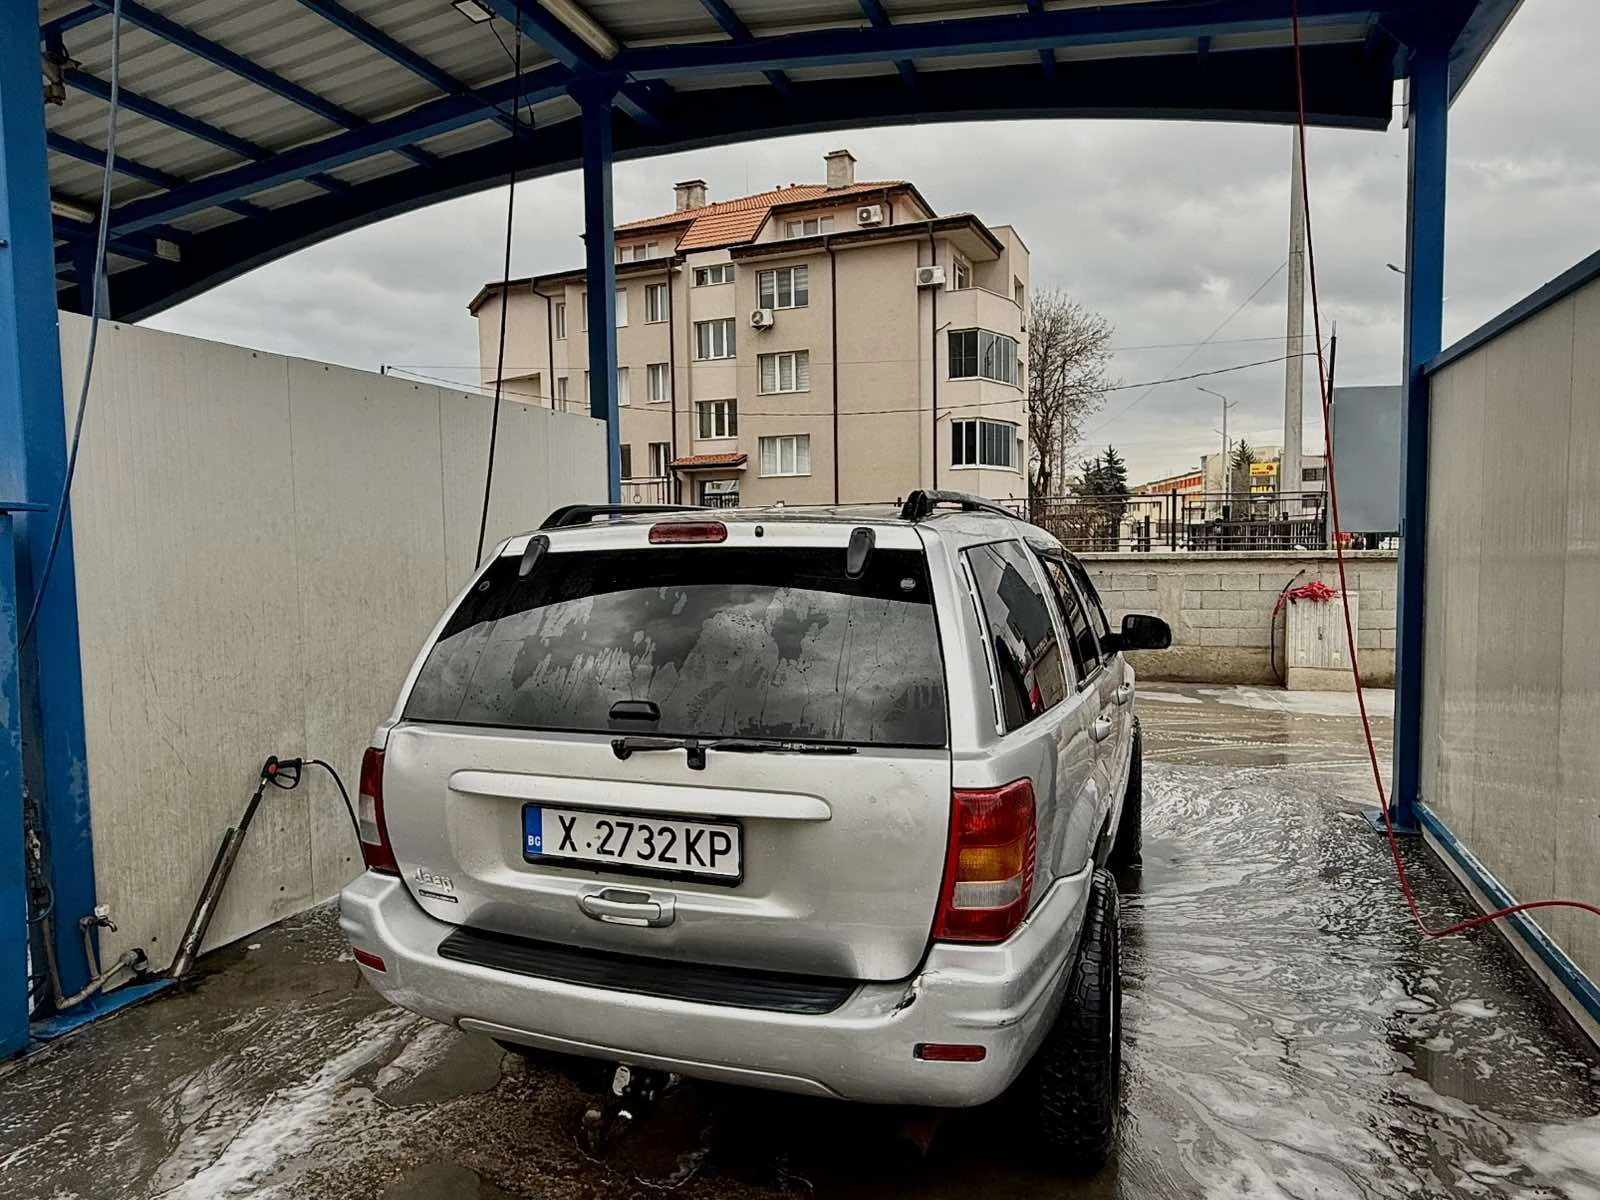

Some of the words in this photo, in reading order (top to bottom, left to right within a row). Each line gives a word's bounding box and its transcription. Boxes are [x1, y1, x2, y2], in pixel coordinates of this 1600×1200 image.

[527, 834, 541, 847] BG
[596, 820, 677, 864] 2732
[415, 868, 454, 893] Jeep
